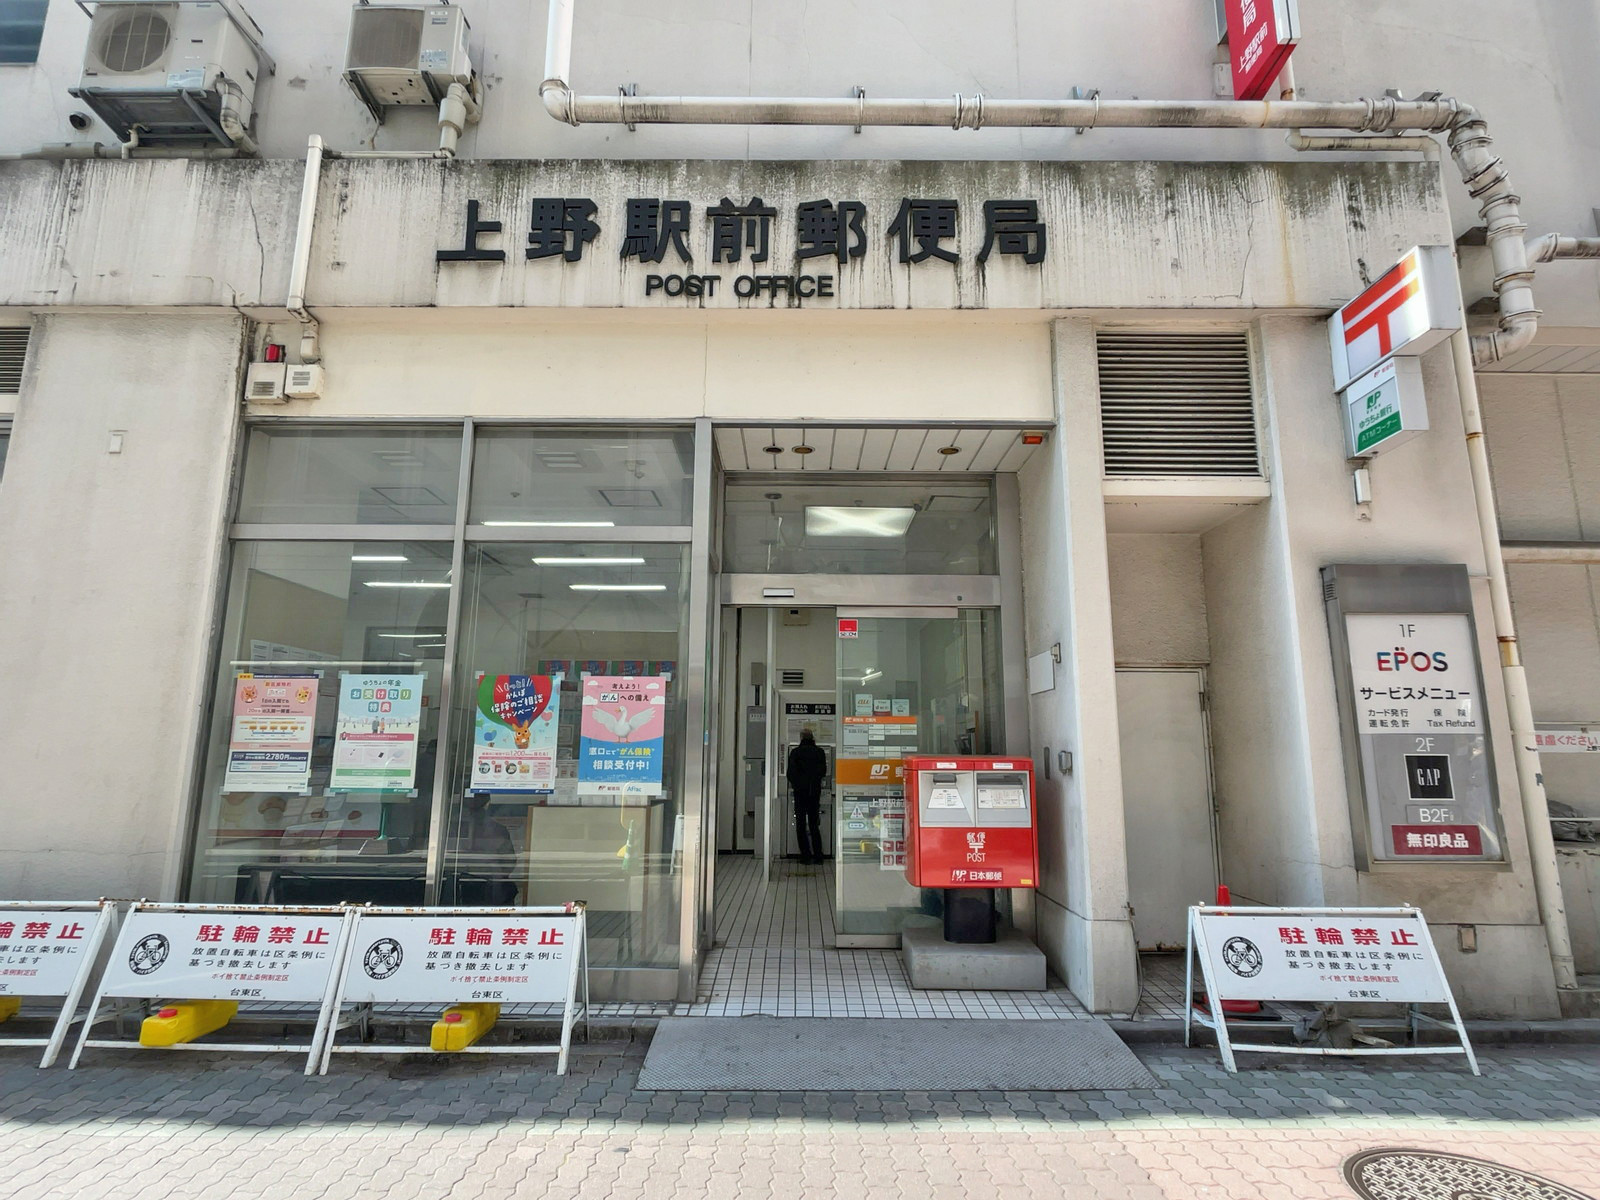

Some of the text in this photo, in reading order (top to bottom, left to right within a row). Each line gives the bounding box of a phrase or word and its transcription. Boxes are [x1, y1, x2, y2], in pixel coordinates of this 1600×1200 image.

[436, 196, 1046, 264] 上野駅前郵便局
[645, 274, 833, 297] POST OFFICE
[1359, 403, 1393, 429] ゆうちょ銀行
[1362, 419, 1397, 442] ATMコーナー
[1399, 624, 1416, 638] 1F
[1377, 647, 1448, 672] EPOS
[351, 689, 411, 700] お受け取り
[505, 688, 526, 700] かんぽ
[1360, 687, 1470, 700] サービスメニュー
[368, 702, 391, 713] 特典
[491, 694, 544, 713] 保険のご相談
[500, 707, 537, 719] キャンペーン
[1368, 709, 1409, 717] カード発行
[1369, 719, 1476, 728] 運転免許 Tax Refund
[1415, 737, 1435, 752] 2F
[593, 760, 649, 770] 相談受付中!
[1417, 768, 1441, 786] GAP
[1419, 808, 1449, 823] B2F
[966, 832, 986, 843] 郵便
[1406, 832, 1469, 848] 無印良品
[966, 853, 986, 862] POST
[970, 871, 1002, 881] 日本郵便
[196, 925, 330, 944] 駐輪禁止
[428, 927, 564, 945] 駐輪禁止
[1278, 927, 1419, 946] 駐輪禁止
[192, 947, 326, 959] 放置自転車は区条例に
[426, 951, 562, 961] 放置自転車は区条例に
[1285, 949, 1424, 960] 放置自転車は区条例に
[188, 958, 292, 970] 基づき撤去します
[425, 962, 529, 971] 基づき撤去します
[1288, 961, 1393, 971] 基づき撤去します
[230, 988, 262, 997] 台東区
[471, 990, 504, 999] 台東区
[1348, 990, 1382, 998] 台東区
